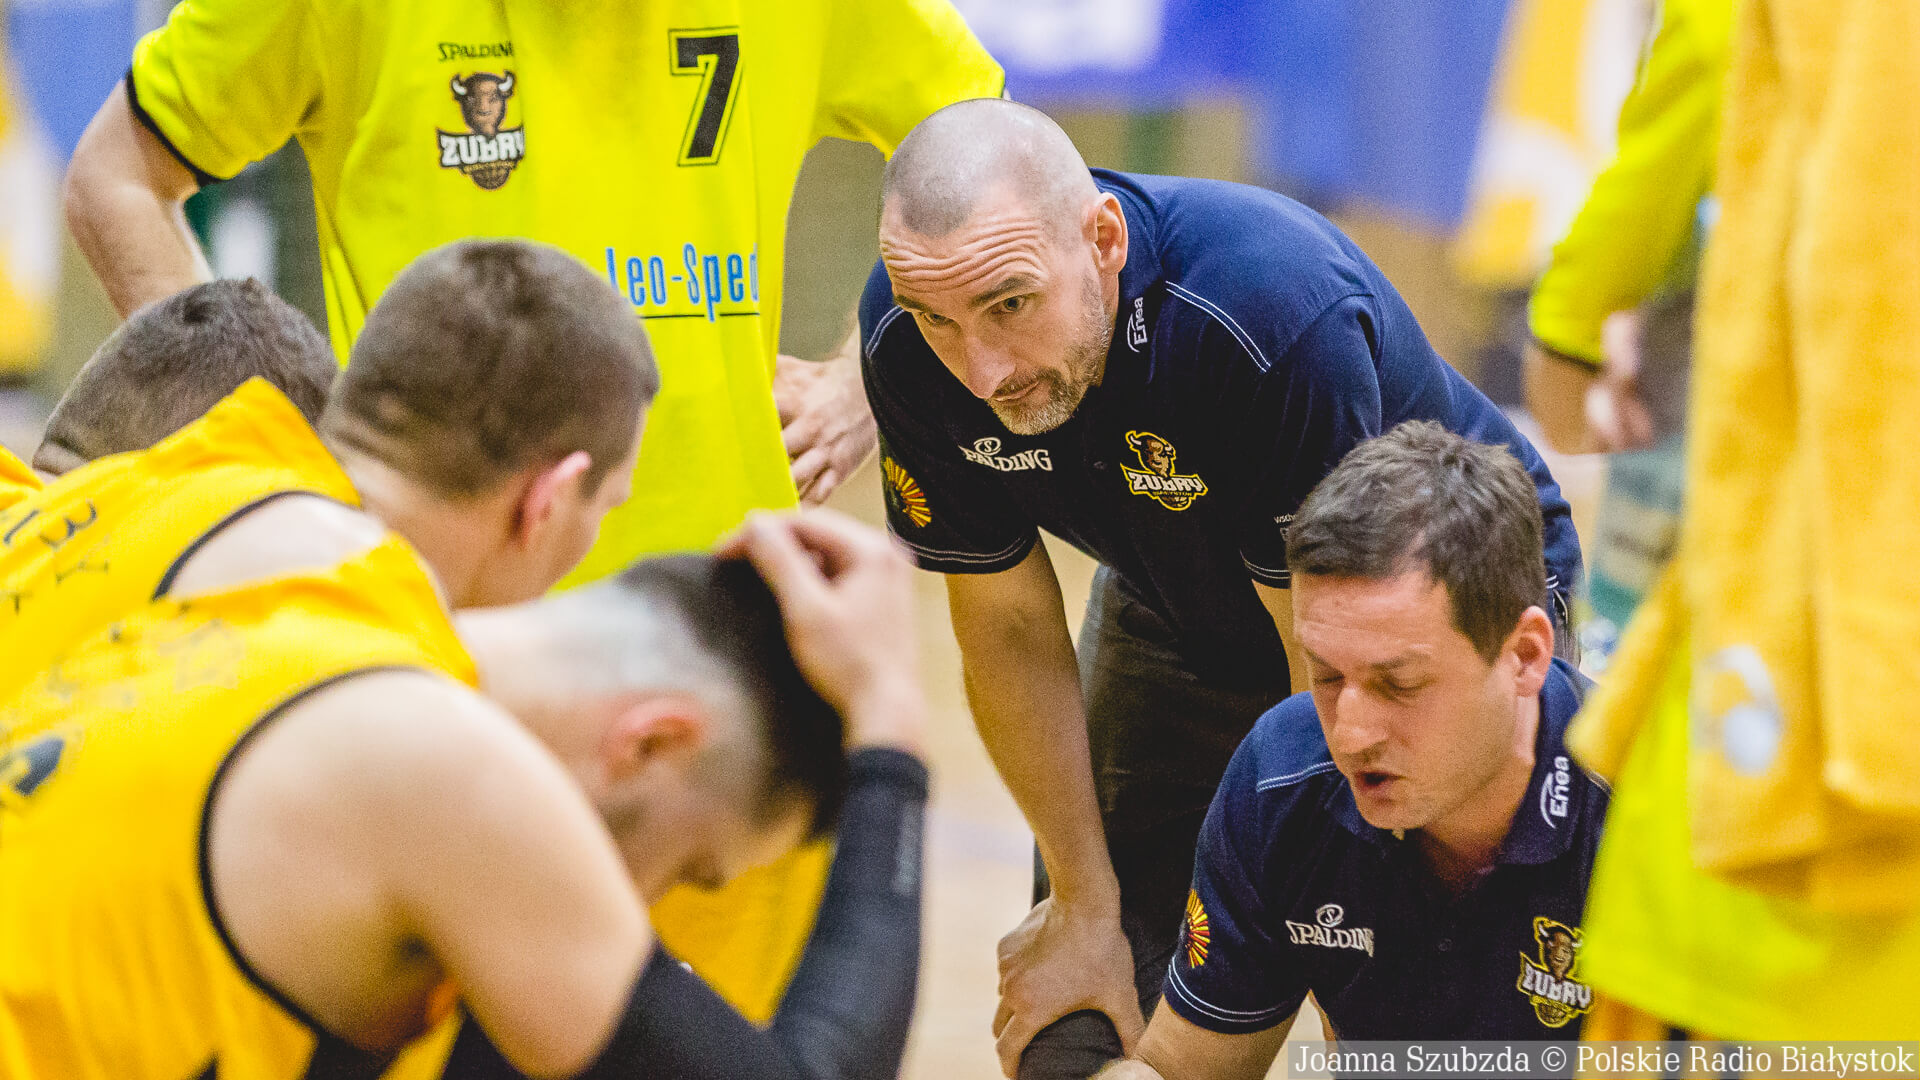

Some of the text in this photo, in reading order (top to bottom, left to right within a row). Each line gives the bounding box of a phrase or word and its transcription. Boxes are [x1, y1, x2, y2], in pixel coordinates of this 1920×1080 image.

[438, 41, 514, 61] SPALDIN
[668, 26, 743, 167] 7
[1132, 297, 1147, 345] Enea
[1548, 756, 1570, 817] Enea
